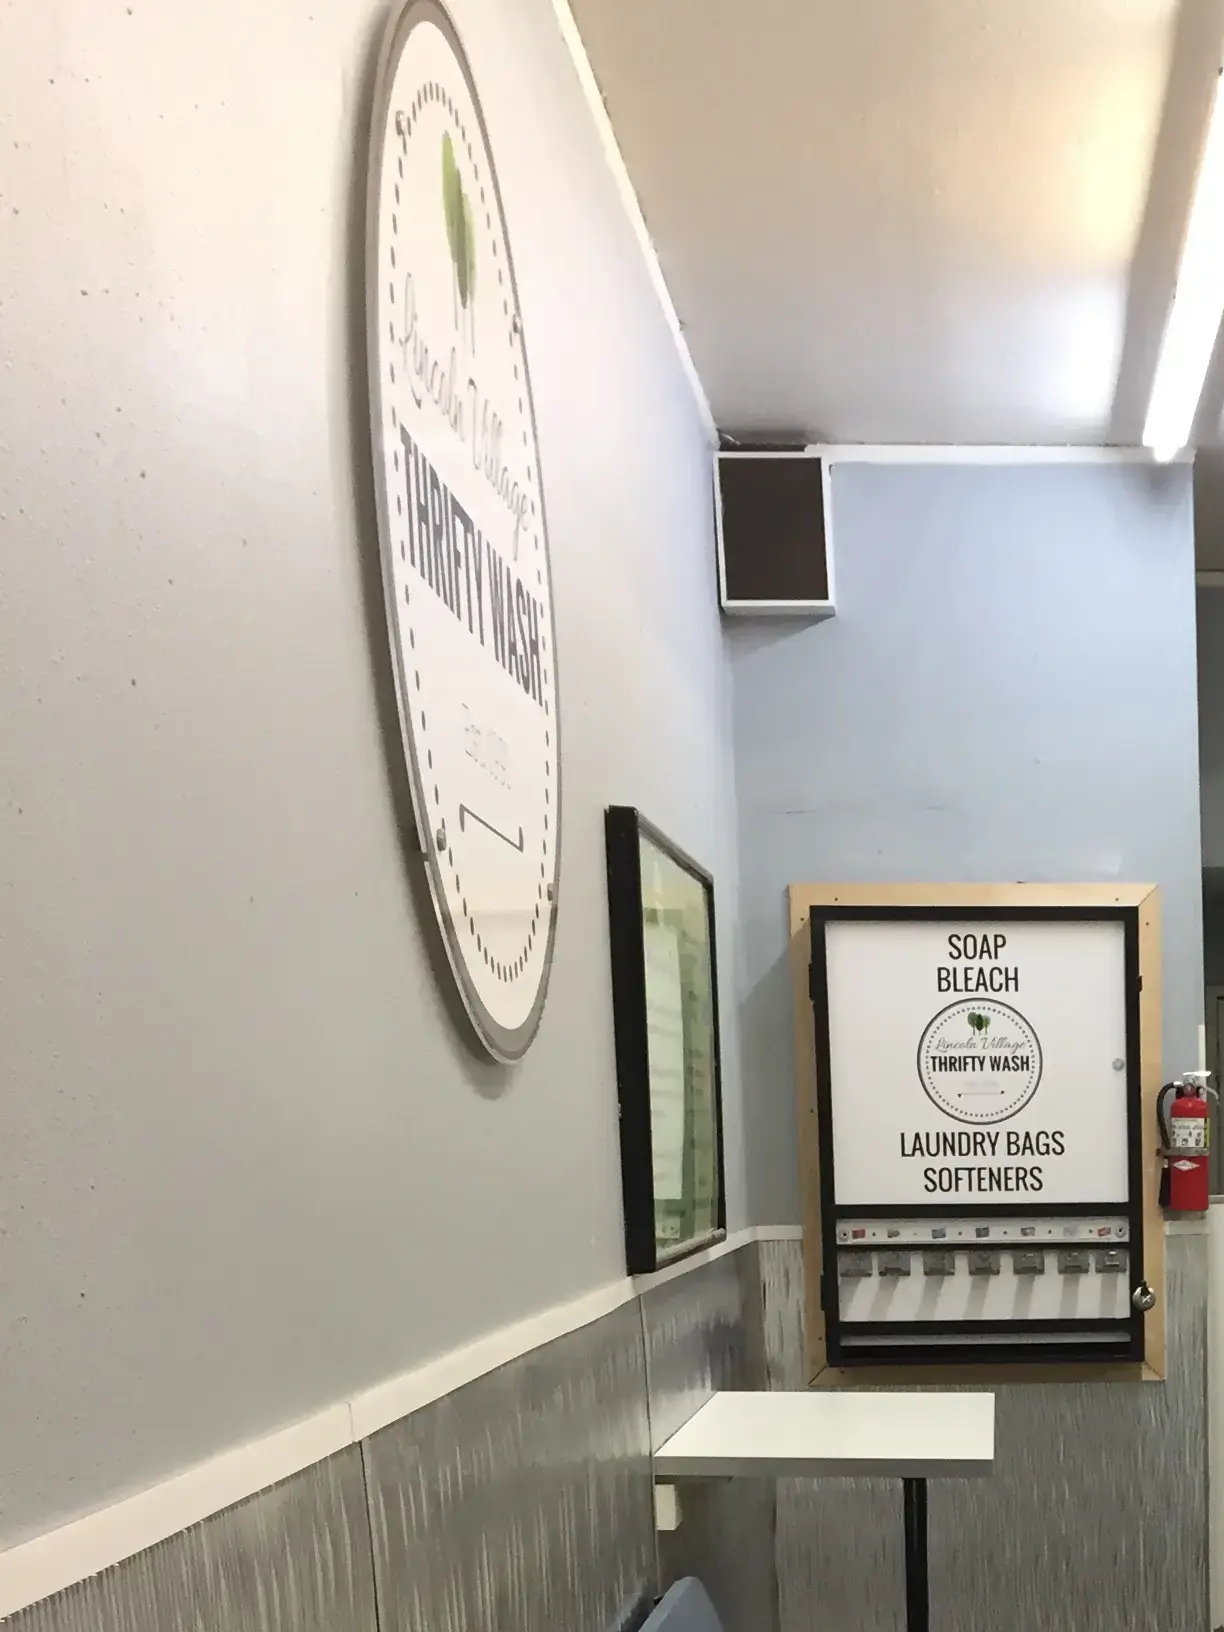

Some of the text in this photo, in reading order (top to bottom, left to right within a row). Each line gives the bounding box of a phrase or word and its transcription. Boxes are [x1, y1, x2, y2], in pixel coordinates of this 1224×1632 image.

[400, 421, 543, 707] THRIFTY WASH
[947, 933, 1007, 961] SOAP
[936, 966, 1019, 993] BLEACH
[935, 1036, 1026, 1054] Lincoln Village
[930, 1055, 1030, 1073] THRIFTY WASH
[900, 1131, 1066, 1158] LAUNDRY BAGS
[923, 1166, 1044, 1193] SOFTENERS
